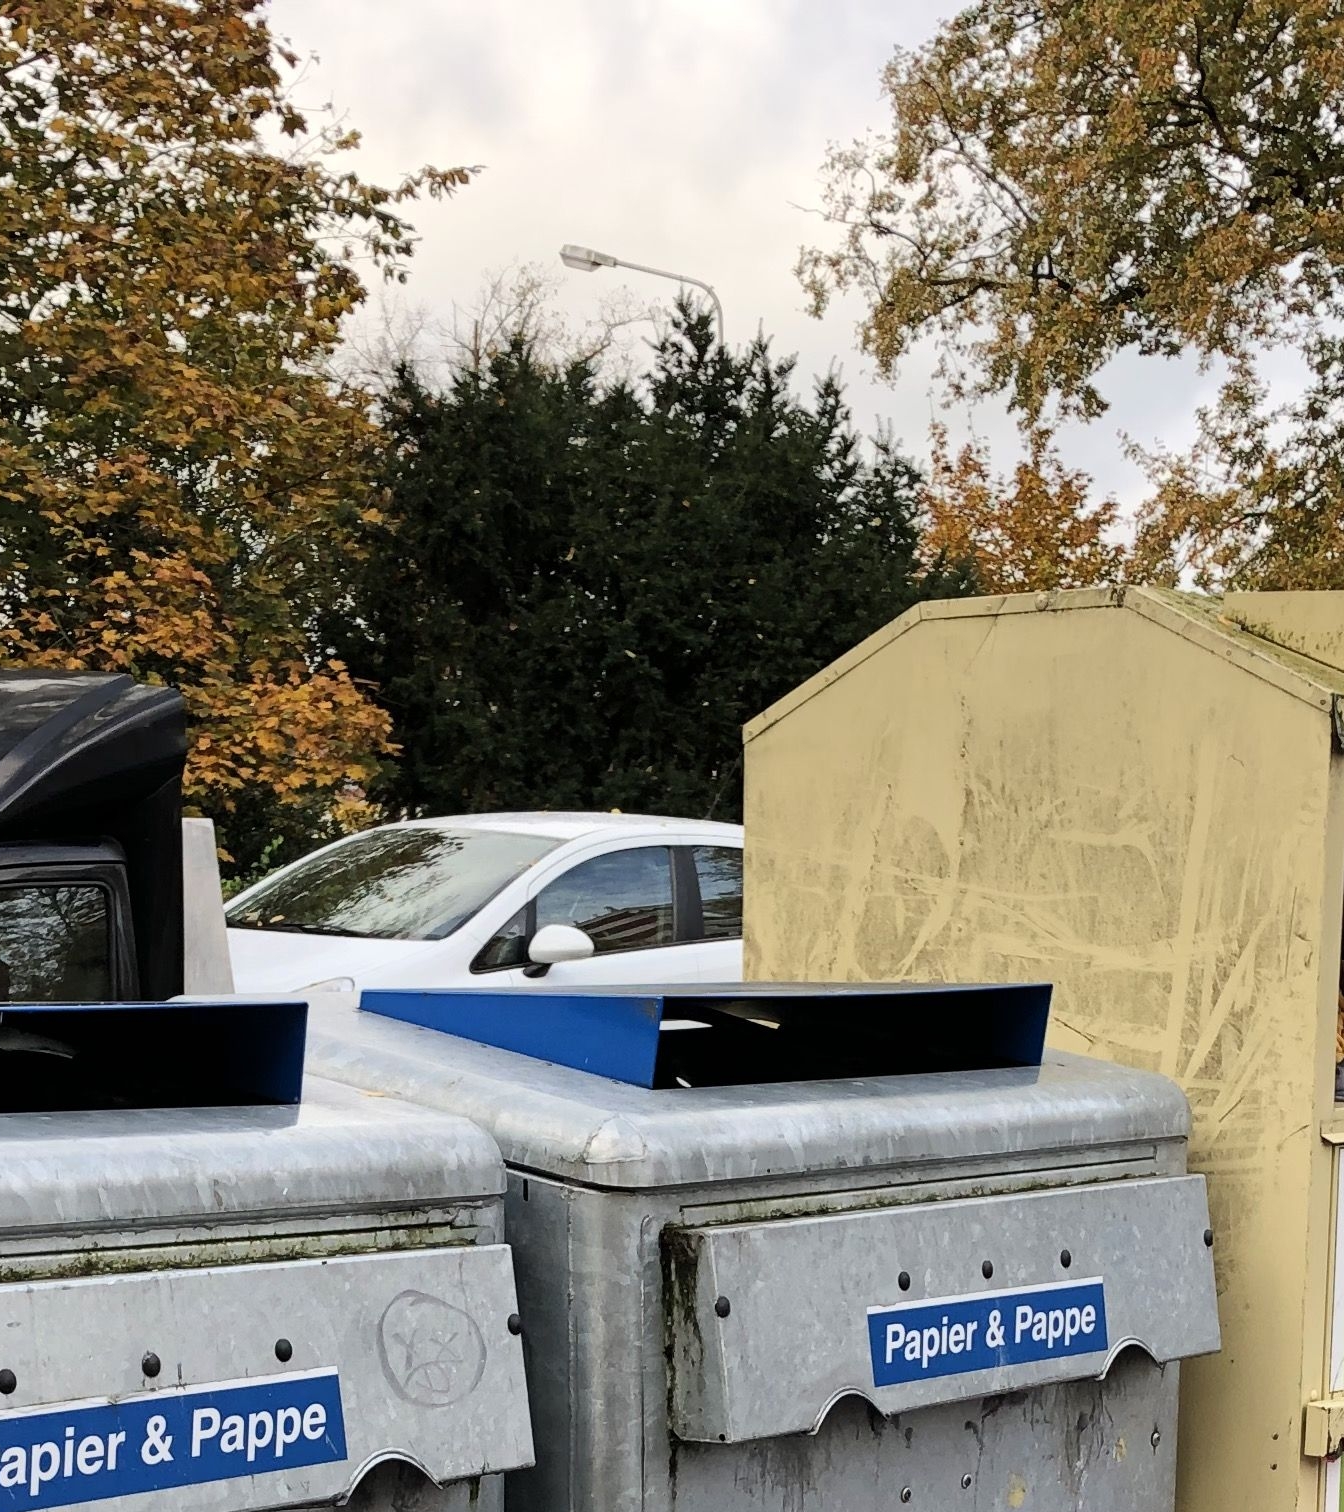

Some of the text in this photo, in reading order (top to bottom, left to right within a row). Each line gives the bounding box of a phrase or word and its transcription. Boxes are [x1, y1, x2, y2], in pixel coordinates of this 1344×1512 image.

[885, 1304, 1096, 1368] Papier & Pappe
[140, 1414, 175, 1465] &
[191, 1402, 327, 1462] Pappe
